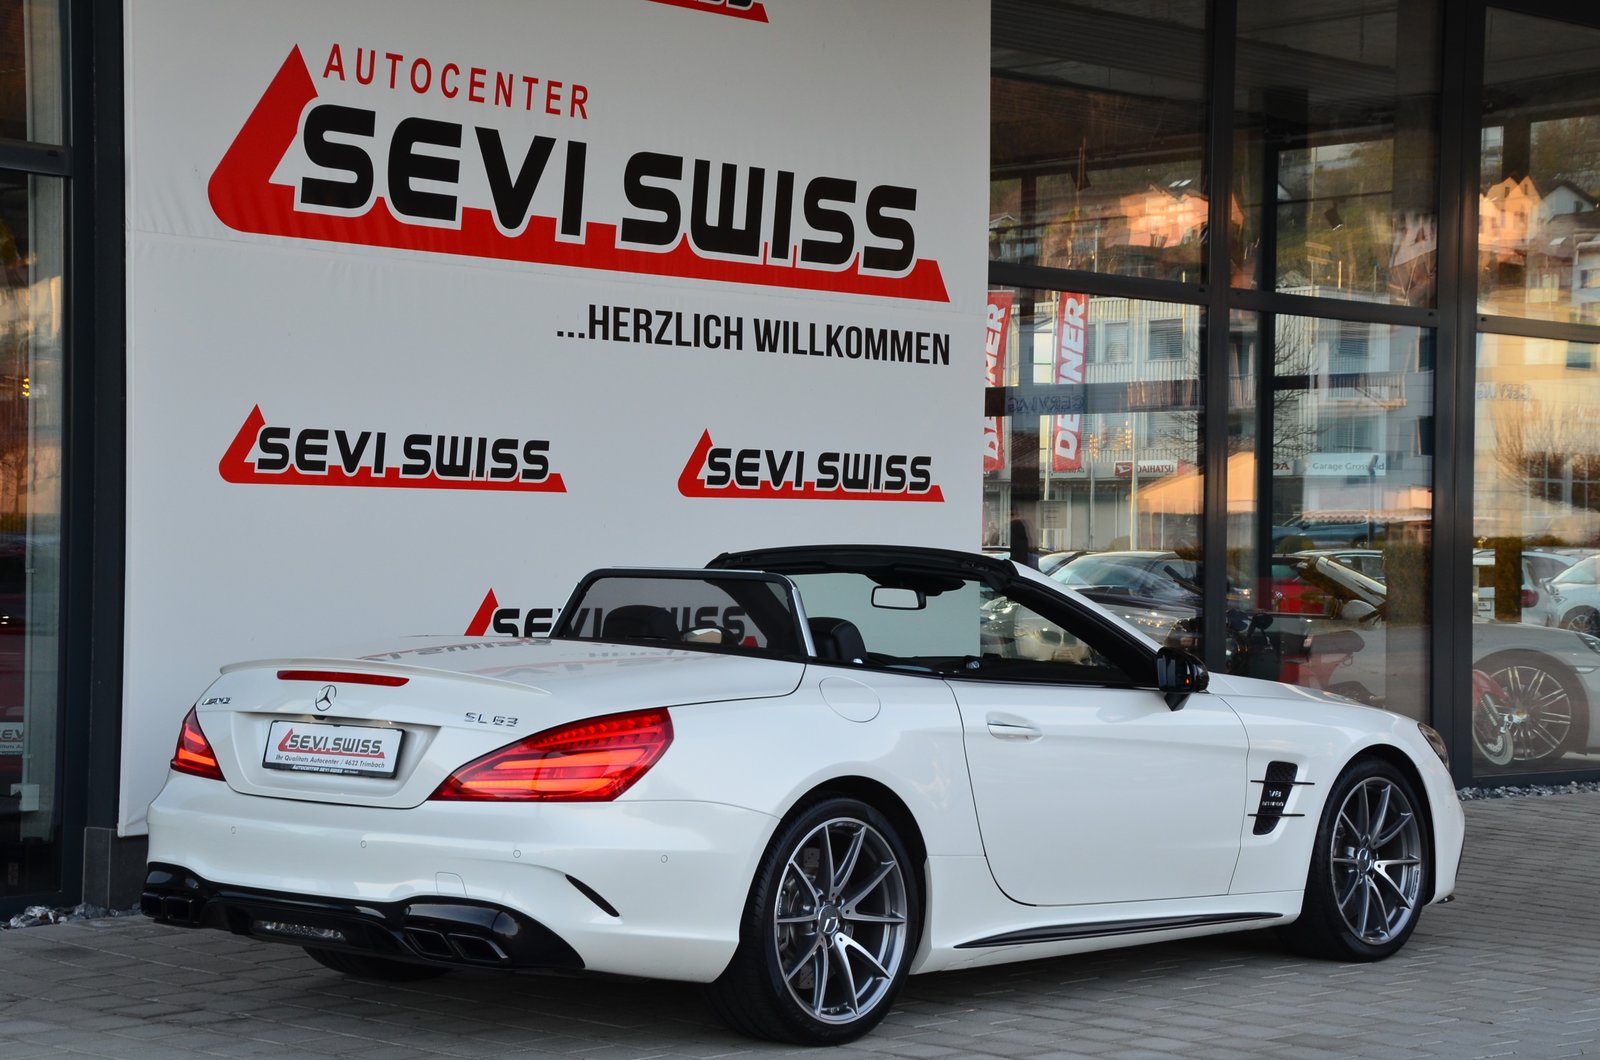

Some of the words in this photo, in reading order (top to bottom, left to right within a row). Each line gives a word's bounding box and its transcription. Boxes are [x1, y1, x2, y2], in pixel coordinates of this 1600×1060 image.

[323, 43, 589, 120] AUTOCENTER
[300, 103, 588, 237] SEVI
[620, 151, 918, 272] SWISS
[753, 318, 951, 366] WILLKOMMEN
[1055, 297, 1085, 460] DENER
[256, 426, 387, 474] SEVI
[401, 433, 550, 480] SWISS
[706, 447, 806, 488] SEVI
[816, 452, 932, 492] SWISS
[1137, 464, 1174, 473] DAIHATSU
[1312, 462, 1343, 472] Garage
[464, 712, 487, 724] SL
[492, 715, 519, 728] 63
[288, 734, 328, 750] SEVI
[331, 738, 383, 754] SWISS
[309, 757, 340, 765] Autocenter
[359, 760, 385, 769] Trimbach
